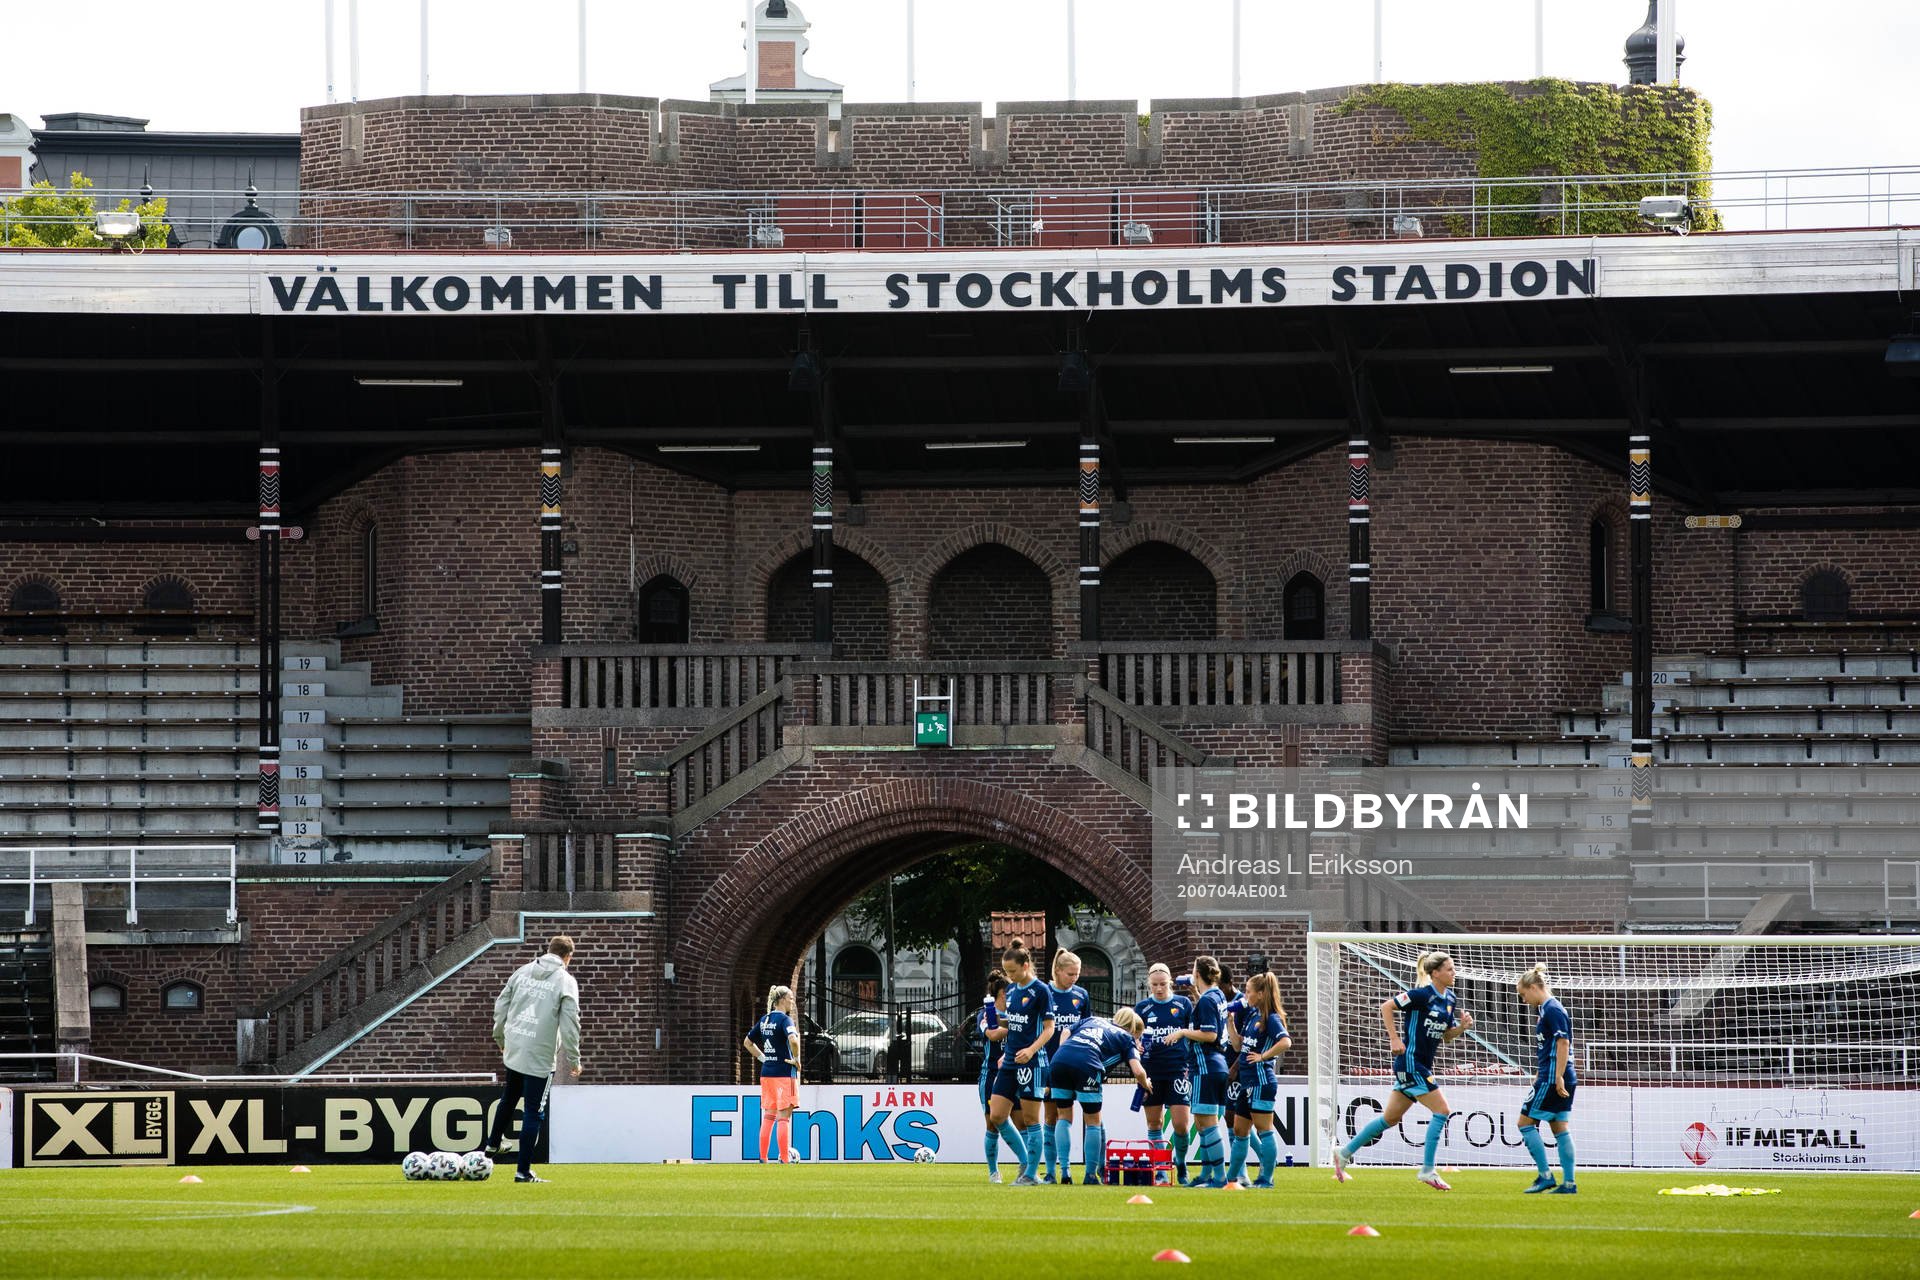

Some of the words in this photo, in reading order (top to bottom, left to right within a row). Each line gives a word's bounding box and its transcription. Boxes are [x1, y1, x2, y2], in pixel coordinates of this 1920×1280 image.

[268, 265, 662, 312] VÄLKOMMEN
[713, 273, 838, 309] TILL
[886, 267, 1286, 309] STOCKHOLMS
[1331, 258, 1596, 301] STADION
[299, 658, 311, 670] 19
[1652, 672, 1667, 684] 20
[298, 685, 310, 696] 18
[298, 712, 310, 723] 17
[296, 739, 308, 750] 16
[295, 767, 307, 778] 15
[1612, 785, 1624, 797] 16
[294, 795, 307, 806] 14
[1600, 815, 1612, 827] 15
[295, 823, 307, 834] 13
[1588, 844, 1600, 856] 14
[295, 852, 307, 863] 12
[872, 1087, 934, 1107] JÄRN
[35, 1101, 162, 1156] XL
[691, 1094, 940, 1161] Flnks
[1399, 1103, 1557, 1149] Grou
[1726, 1127, 1750, 1146] IF
[1753, 1128, 1866, 1149] METALL
[1845, 1154, 1866, 1164] Län
